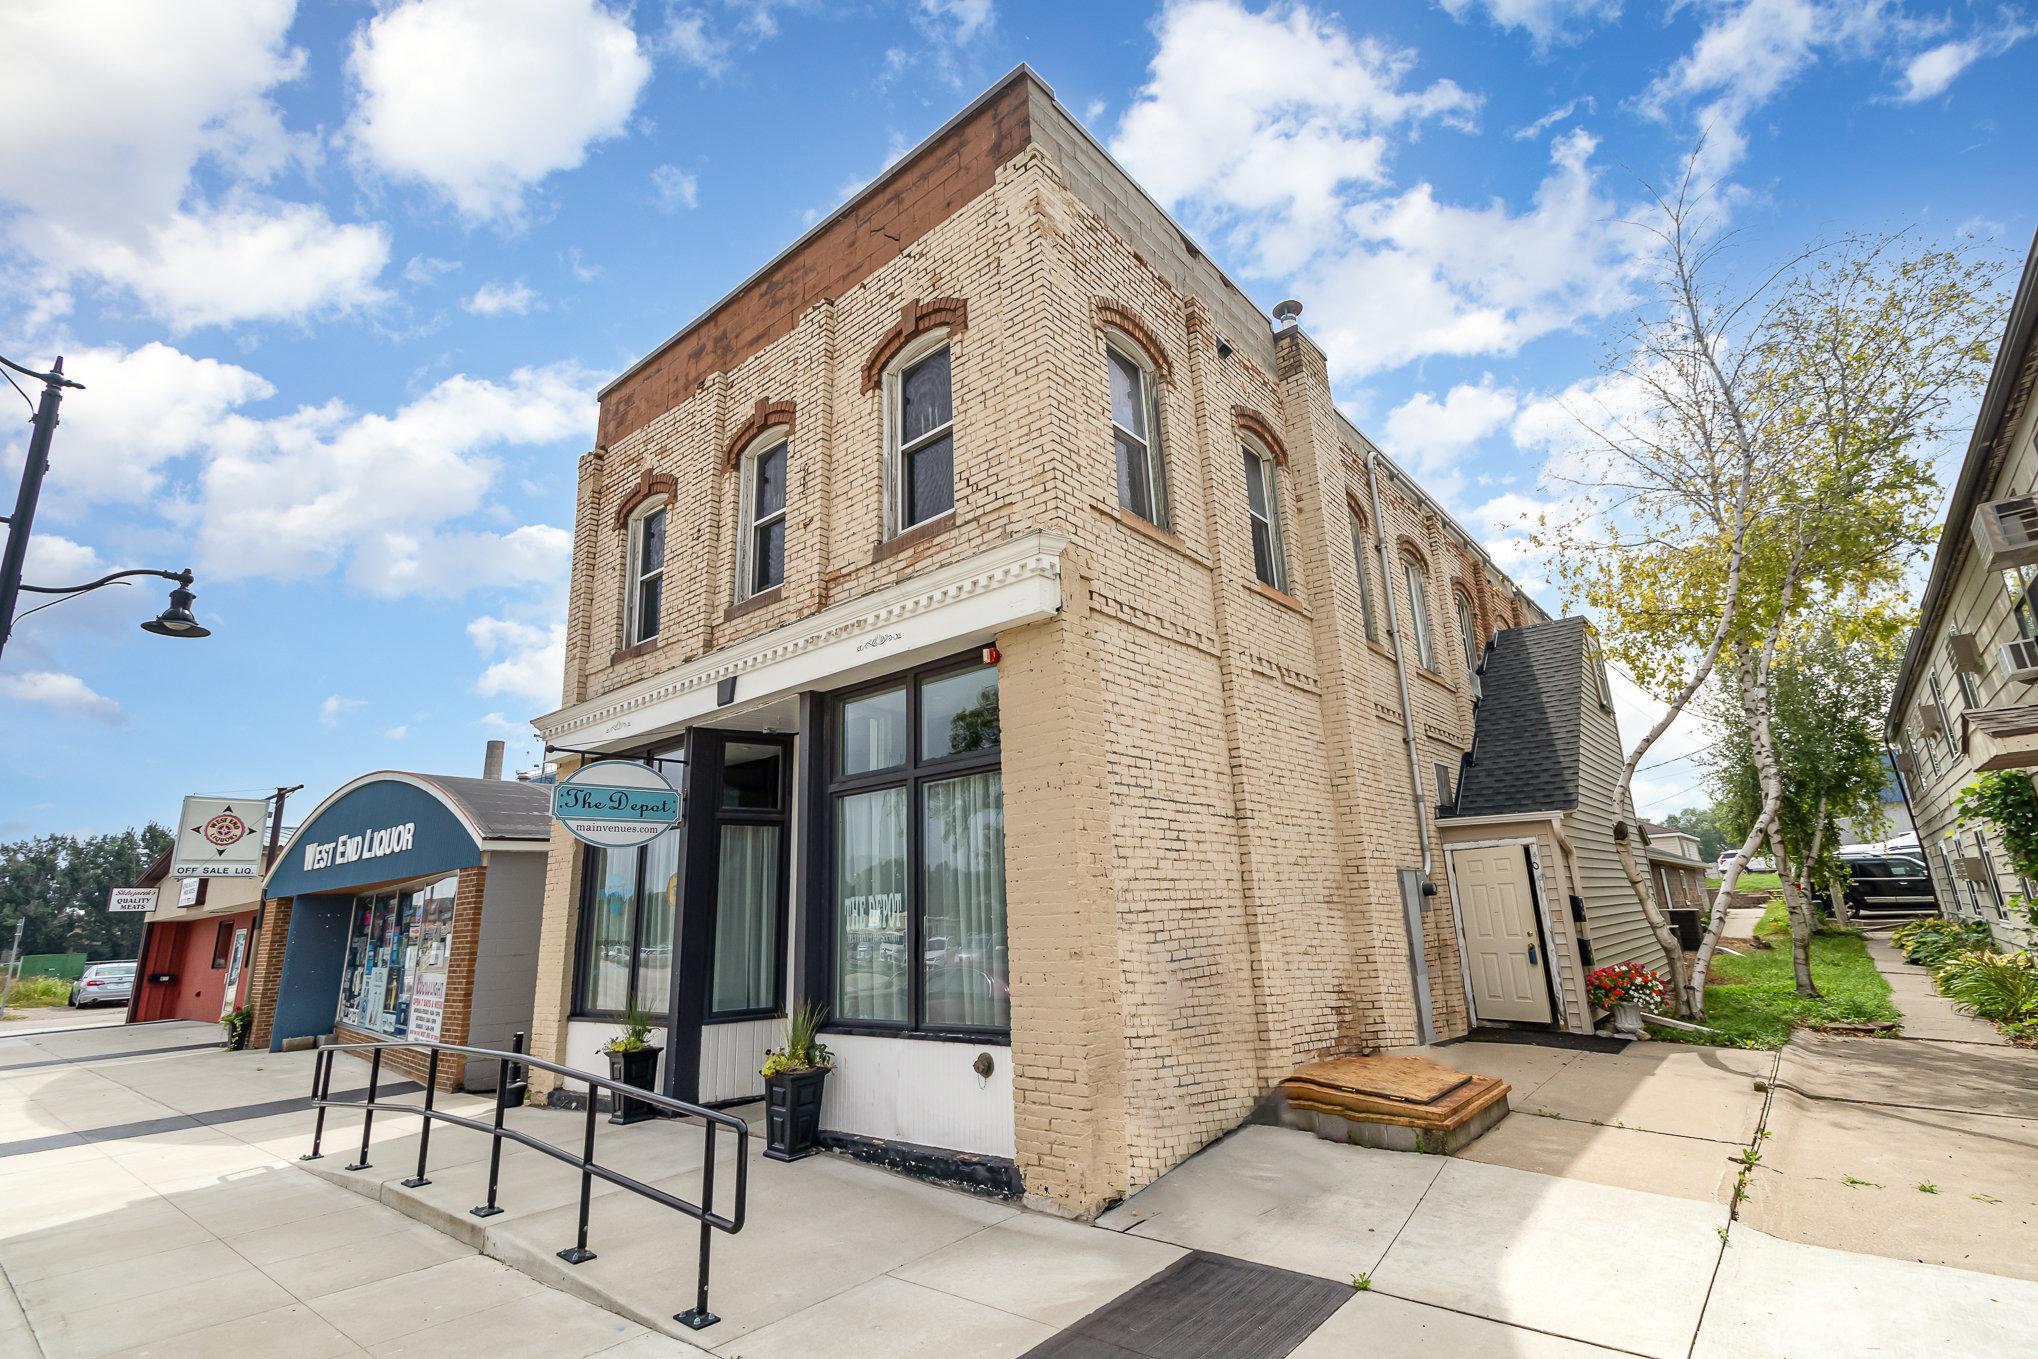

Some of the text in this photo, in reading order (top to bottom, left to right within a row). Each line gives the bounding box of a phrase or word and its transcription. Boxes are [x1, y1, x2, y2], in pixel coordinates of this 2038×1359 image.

[564, 788, 671, 818] The Depot
[210, 818, 240, 830] WEST END
[576, 822, 658, 834] mainvenues.com
[362, 822, 416, 859] LIQUOR
[176, 867, 254, 875] OFF SALE LIQ.
[845, 893, 902, 930] THE DEPOT
